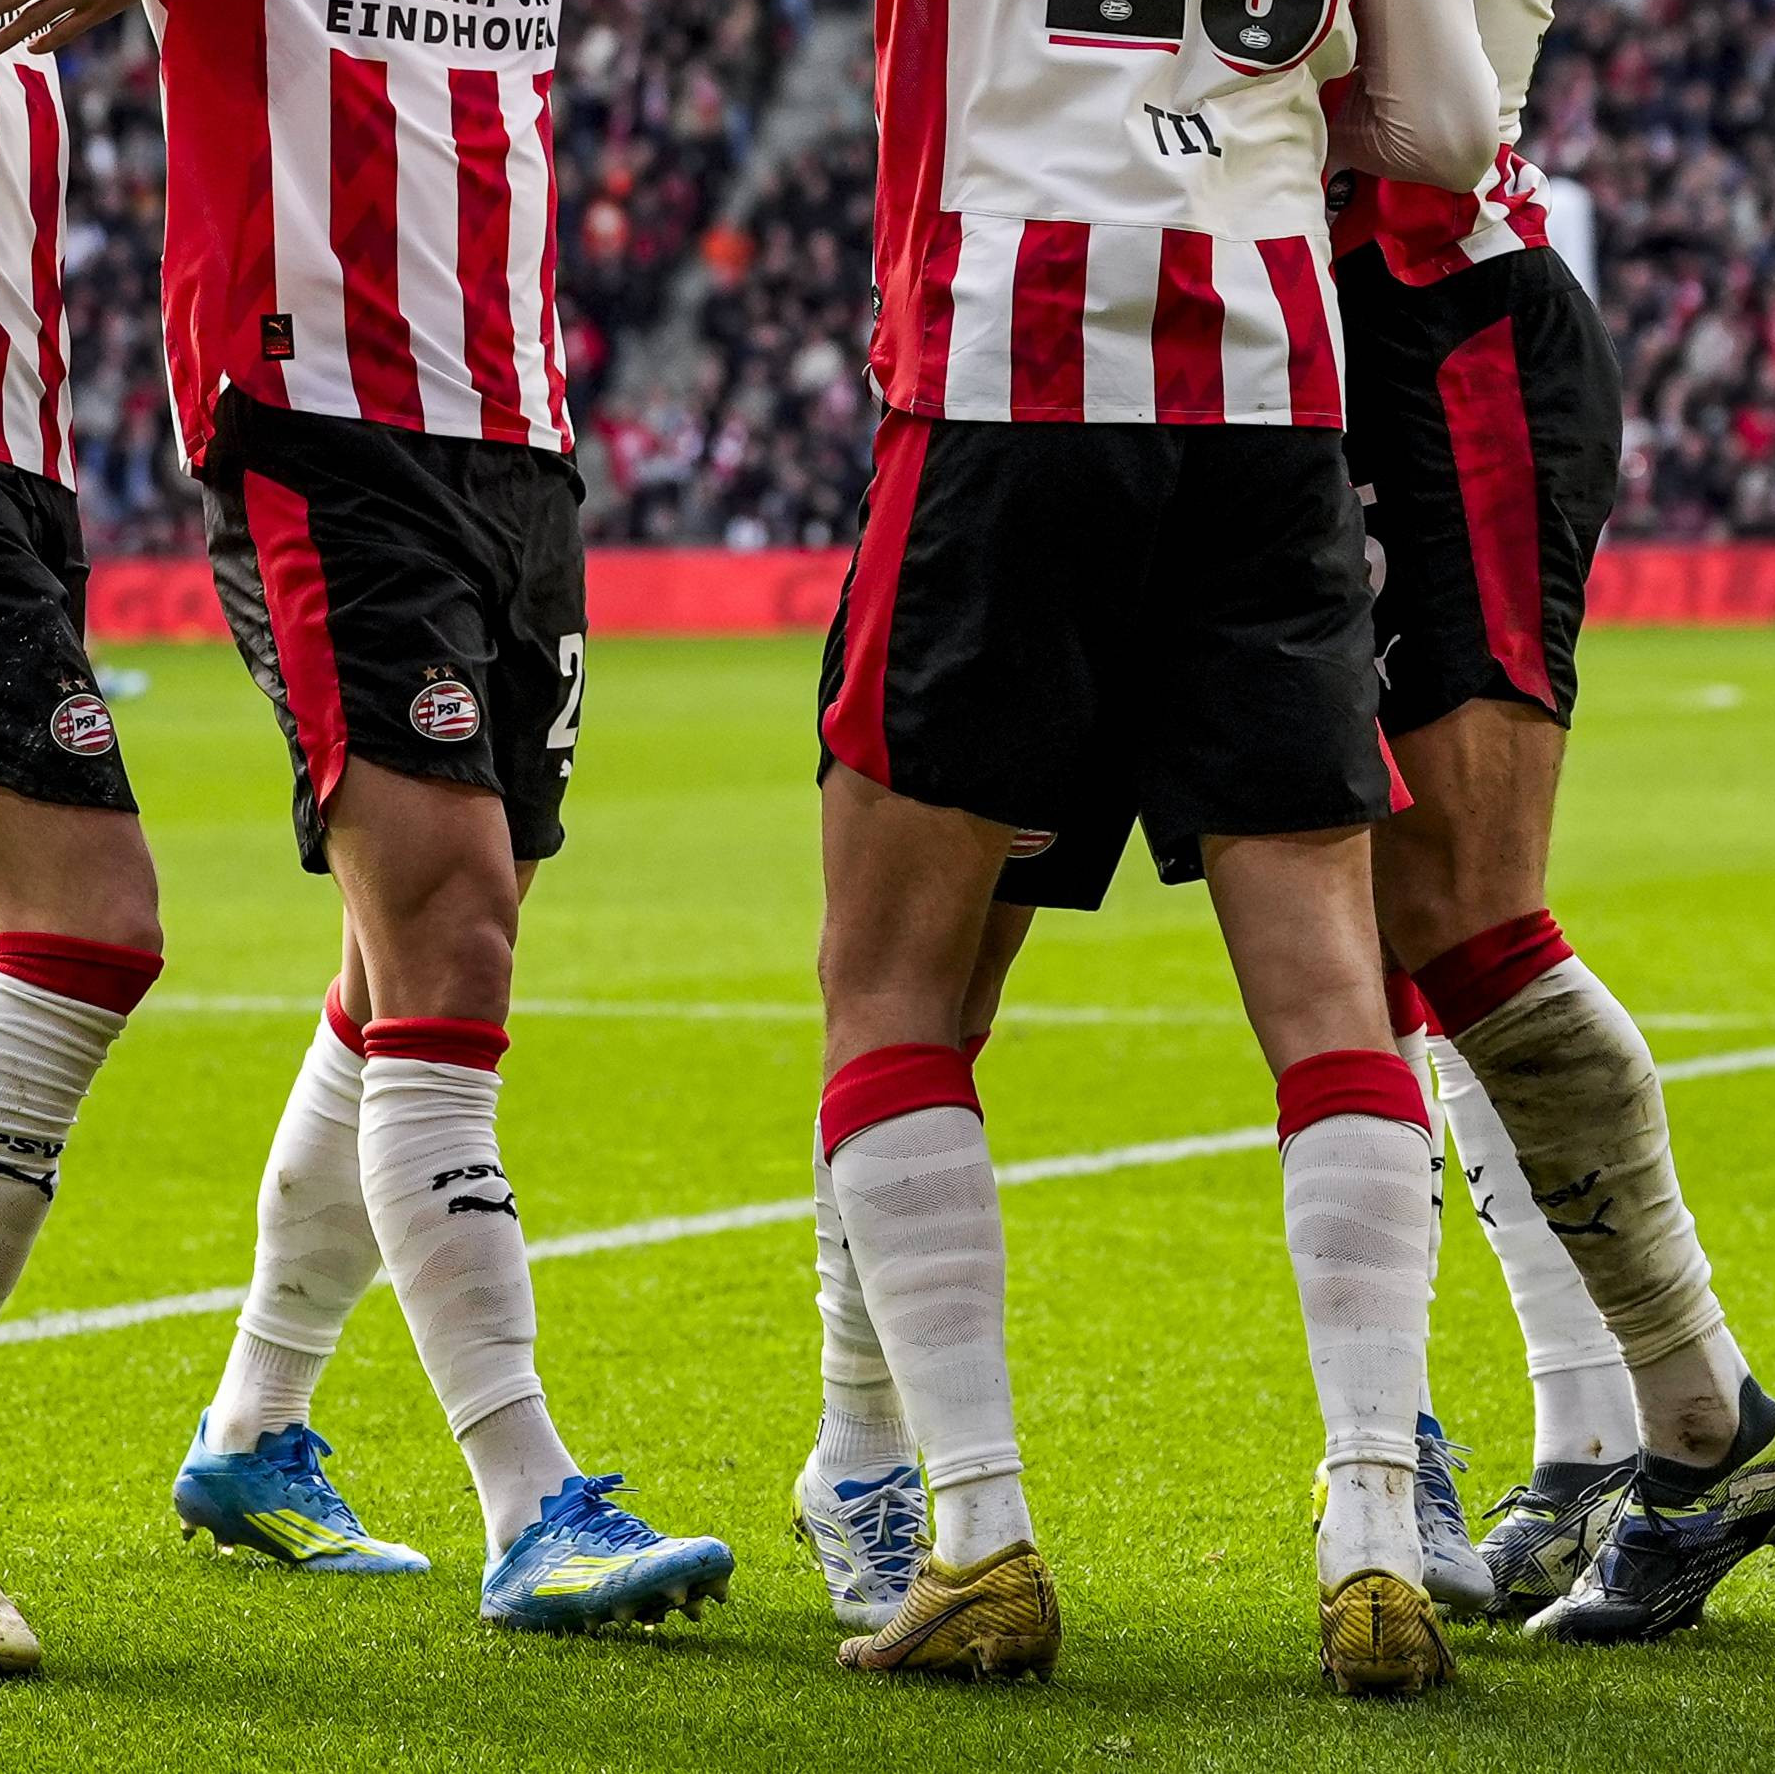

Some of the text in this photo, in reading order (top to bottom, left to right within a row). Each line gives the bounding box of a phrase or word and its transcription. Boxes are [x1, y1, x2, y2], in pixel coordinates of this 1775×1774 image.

[1144, 103, 1222, 158] TIL
[437, 701, 462, 717] PSV
[75, 715, 97, 730] PSV
